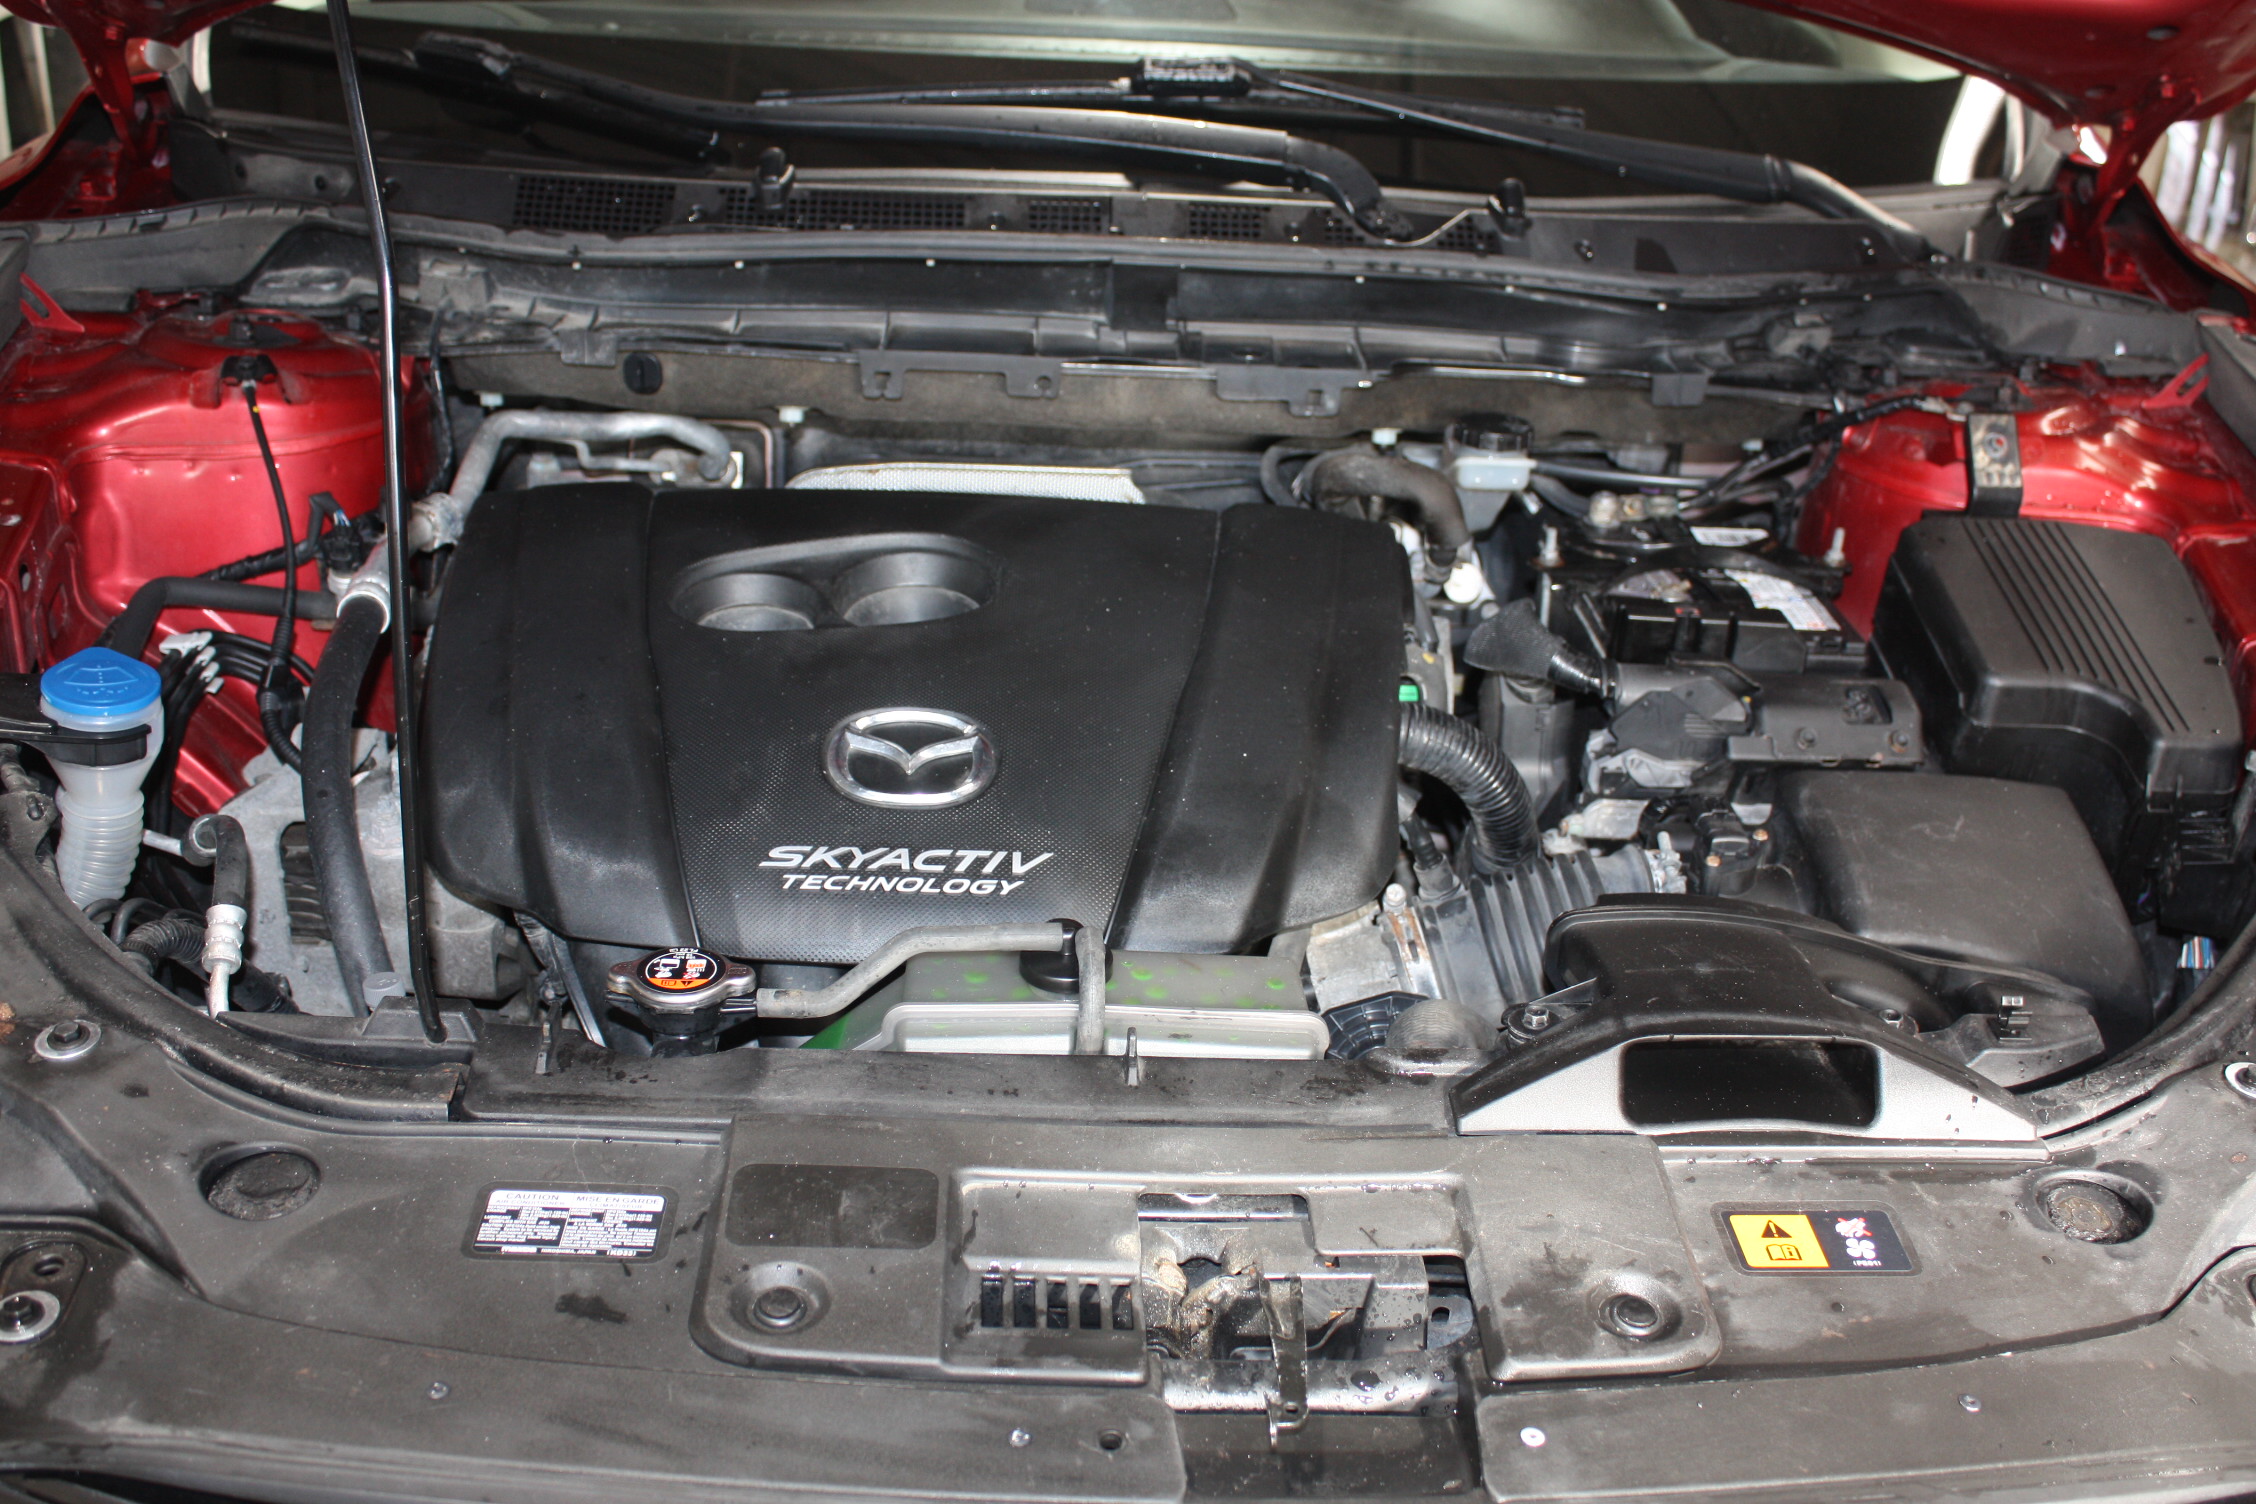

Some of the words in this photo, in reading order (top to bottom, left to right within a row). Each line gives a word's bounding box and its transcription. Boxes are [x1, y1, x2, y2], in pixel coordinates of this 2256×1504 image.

[758, 845, 1054, 875] SKYACTIV
[782, 874, 1025, 895] TECHNOLOGY
[506, 1193, 560, 1201] CAUTION
[622, 1197, 660, 1205] GARDE
